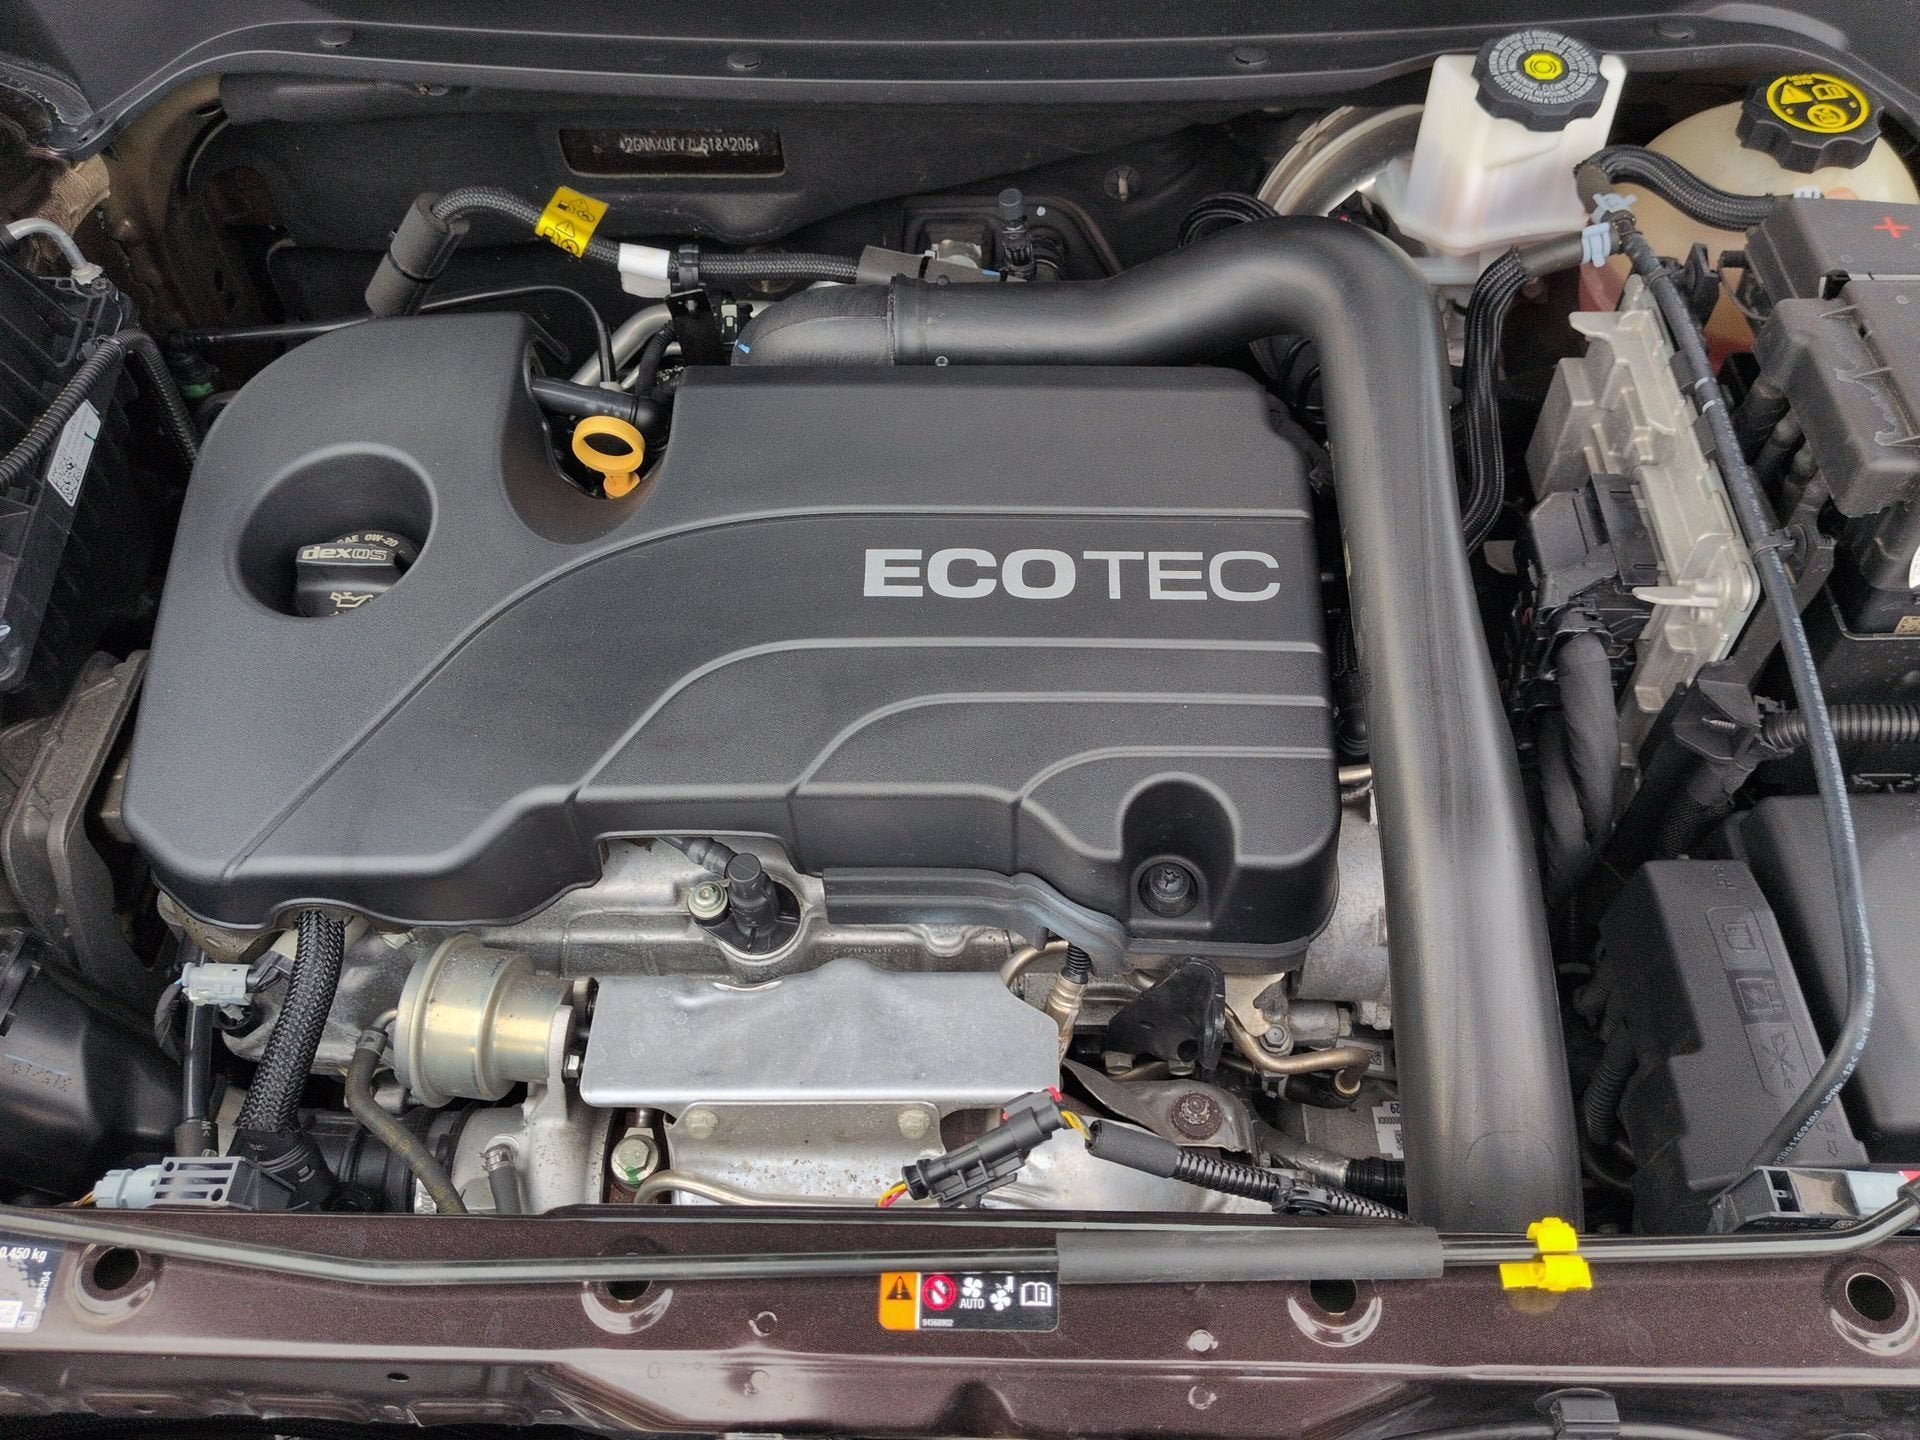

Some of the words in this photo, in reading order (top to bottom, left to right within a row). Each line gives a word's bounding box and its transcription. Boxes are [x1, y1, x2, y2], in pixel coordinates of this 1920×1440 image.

[365, 533, 399, 547] 0W-20
[302, 546, 388, 561] dexos
[863, 548, 1281, 601] ECOTEC
[32, 1248, 48, 1263] kg
[959, 1298, 985, 1310] AUTO
